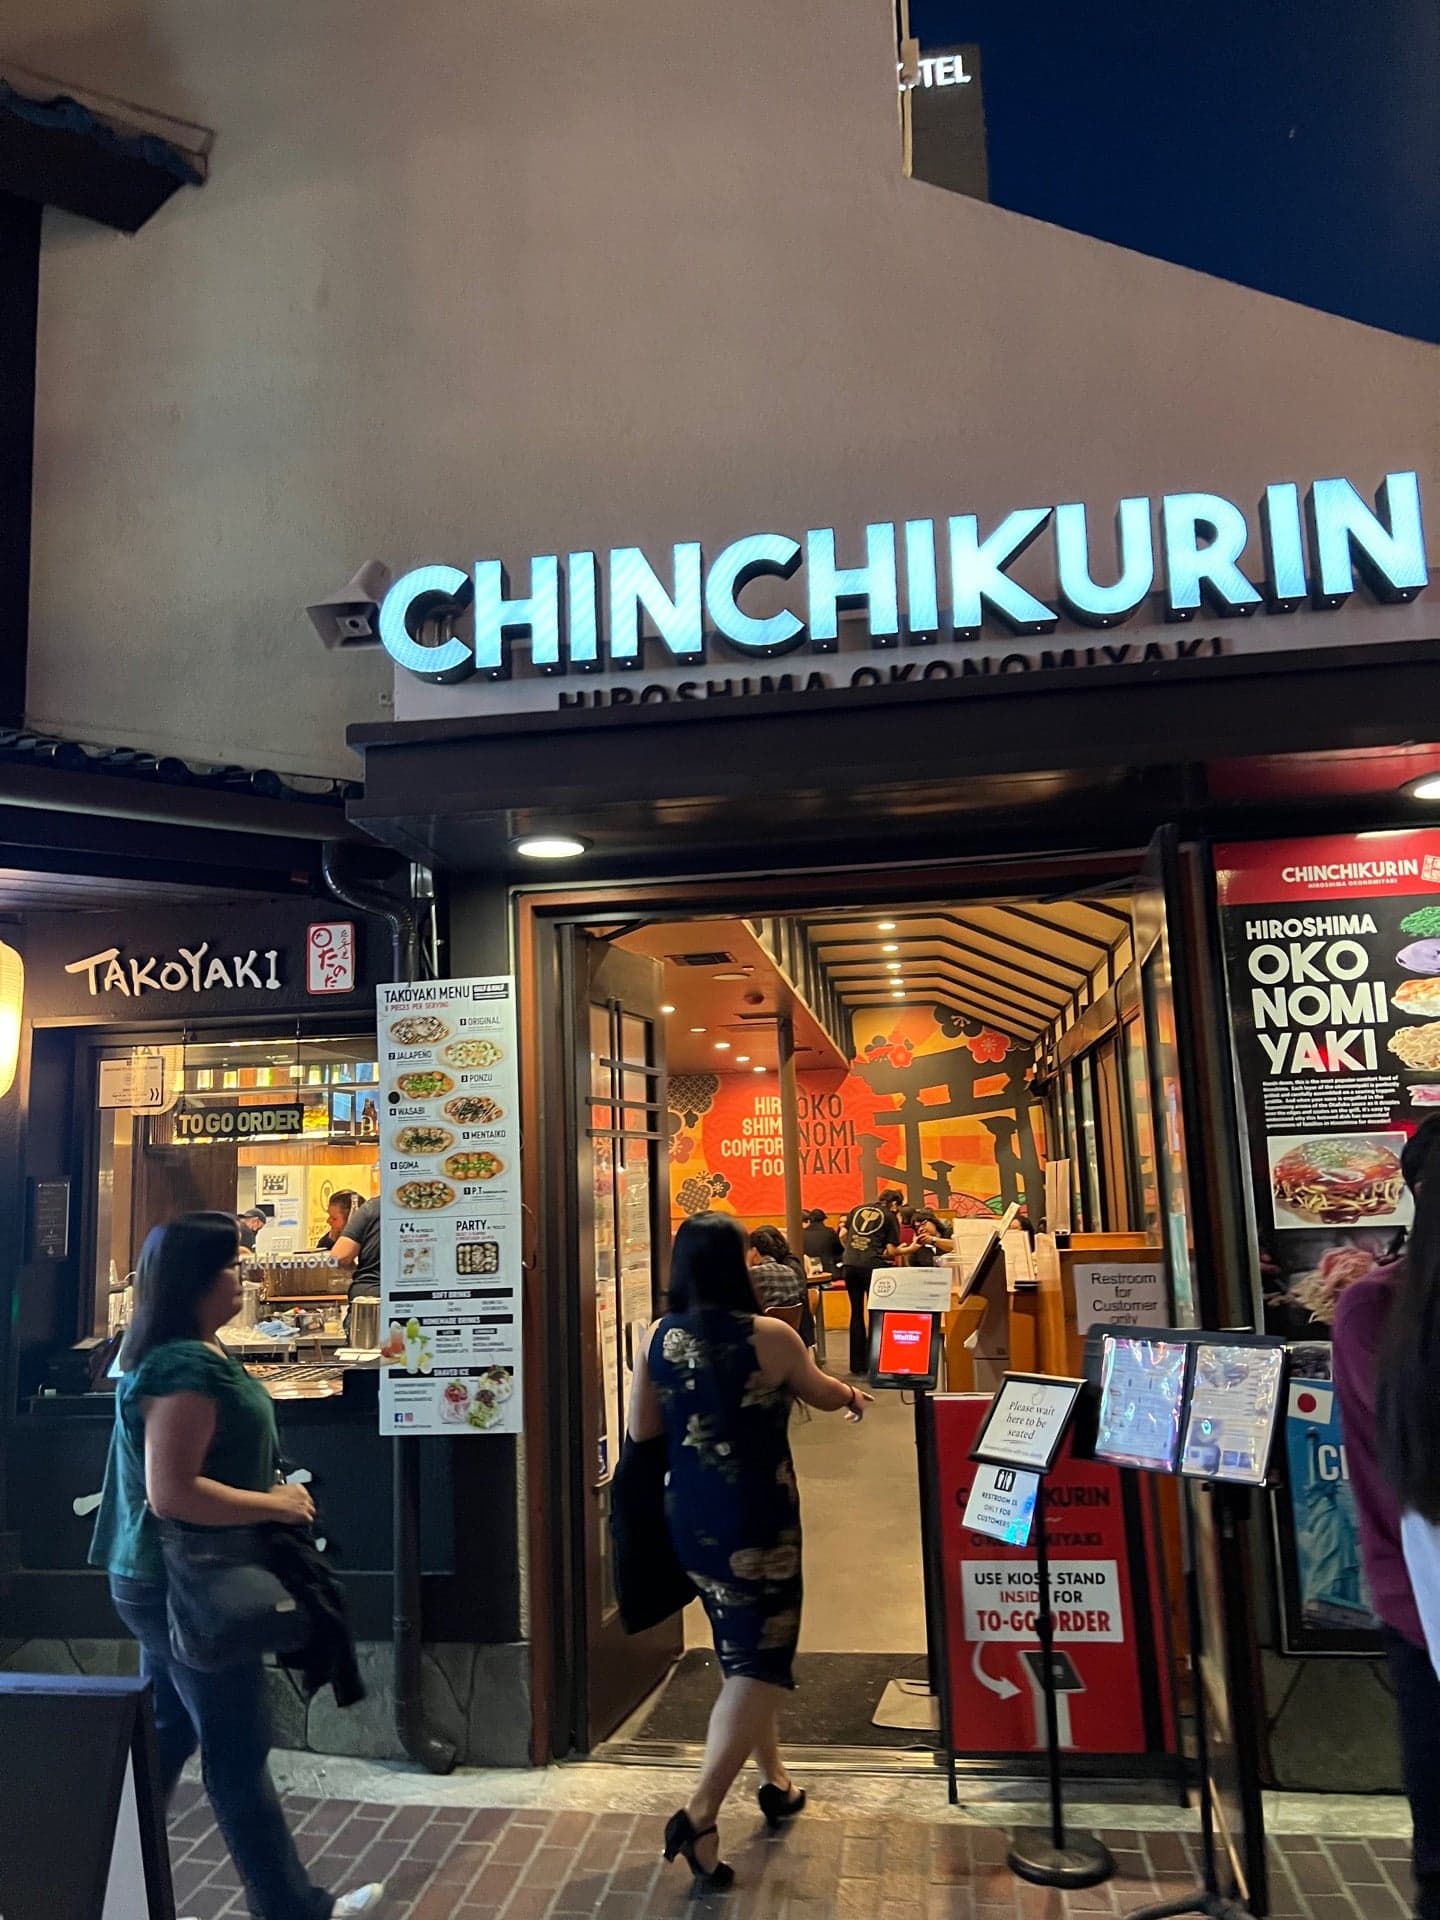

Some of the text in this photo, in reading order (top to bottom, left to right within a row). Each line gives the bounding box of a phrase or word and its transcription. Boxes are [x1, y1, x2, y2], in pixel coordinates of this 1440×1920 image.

[379, 471, 1428, 676] CHINCHIKURIN
[1282, 859, 1418, 883] CHINCHIKURIN
[1246, 914, 1377, 940] HIROSHIMA
[65, 942, 281, 996] TAKOYAKI
[1248, 940, 1369, 984] OKO
[384, 988, 437, 1003] TAKOYAKI
[440, 985, 470, 999] MENU
[1252, 982, 1389, 1028] NOMI
[1257, 1029, 1378, 1074] YAKI
[754, 1096, 782, 1116] HIR
[798, 1094, 842, 1120] OKO
[179, 1110, 300, 1135] TO GO ORDER
[742, 1116, 782, 1136] SHIM
[798, 1120, 855, 1147] NOMI
[721, 1137, 784, 1158] COMFOR
[752, 1158, 784, 1178] FOO
[800, 1148, 850, 1175] YAKI
[456, 1220, 487, 1231] PARTY
[1091, 1273, 1157, 1284] Restroom
[1115, 1286, 1132, 1298] for
[1093, 1300, 1158, 1312] Customer
[434, 1368, 470, 1376] SHAVED ICE
[1009, 1402, 1056, 1416] Please wait
[1006, 1414, 1047, 1428] here to be
[1007, 1429, 1036, 1440] seated
[982, 1491, 1010, 1506] RESTROOM
[984, 1504, 1011, 1516] ONLY FOR
[976, 1514, 1010, 1528] CUSTOMERS
[975, 1573, 1002, 1585] USE
[1057, 1572, 1106, 1585] STAND
[1000, 1590, 1083, 1603] INSID FOR
